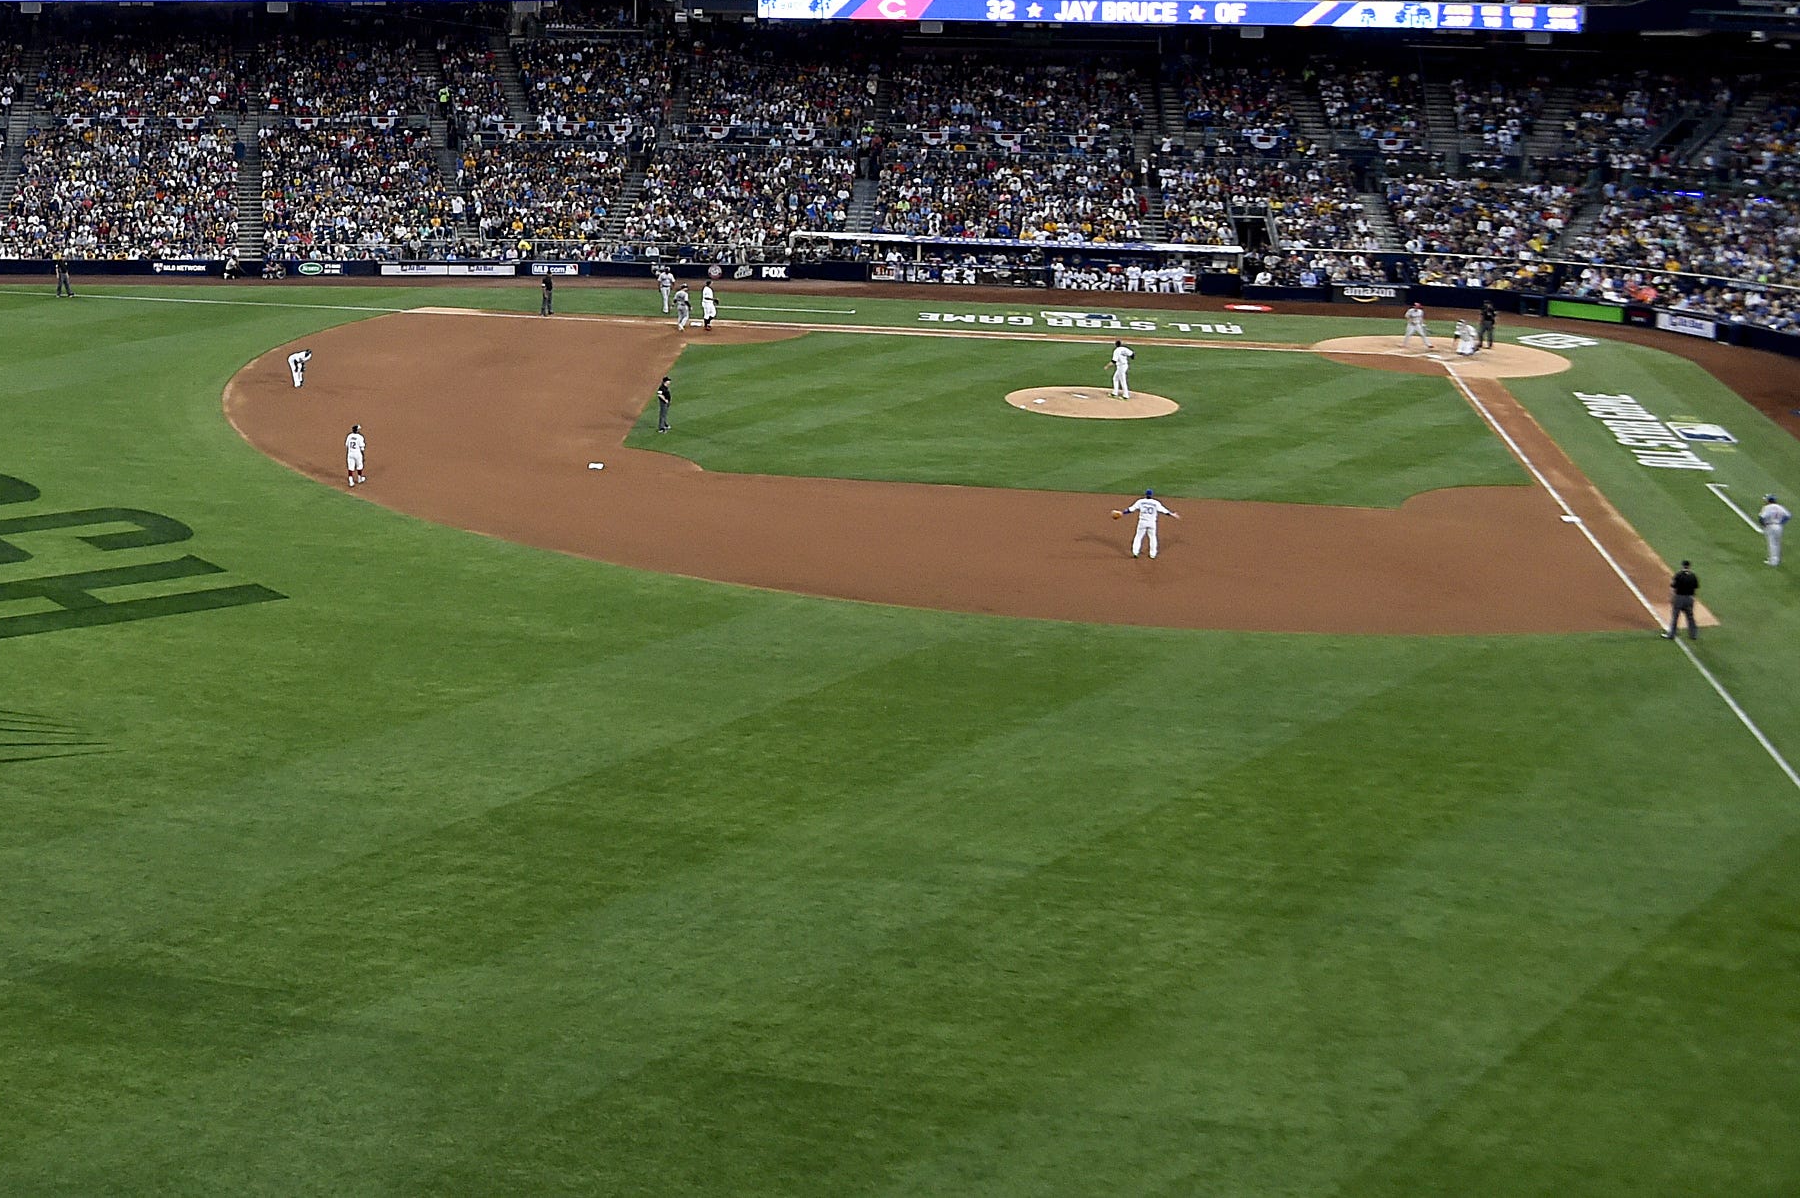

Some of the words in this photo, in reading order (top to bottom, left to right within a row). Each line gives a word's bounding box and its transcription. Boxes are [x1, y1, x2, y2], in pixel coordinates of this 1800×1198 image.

[986, 0, 1015, 20] 32
[1055, 1, 1096, 21] JAY
[1101, 1, 1178, 22] BRUCE
[1214, 2, 1248, 23] OF
[762, 266, 787, 278] FOX
[1343, 286, 1396, 297] amazon
[918, 312, 1034, 326] GAME
[1047, 317, 1157, 331] STAR
[1168, 322, 1243, 335] ALL
[349, 441, 357, 450] 12
[1143, 505, 1154, 515] 20
